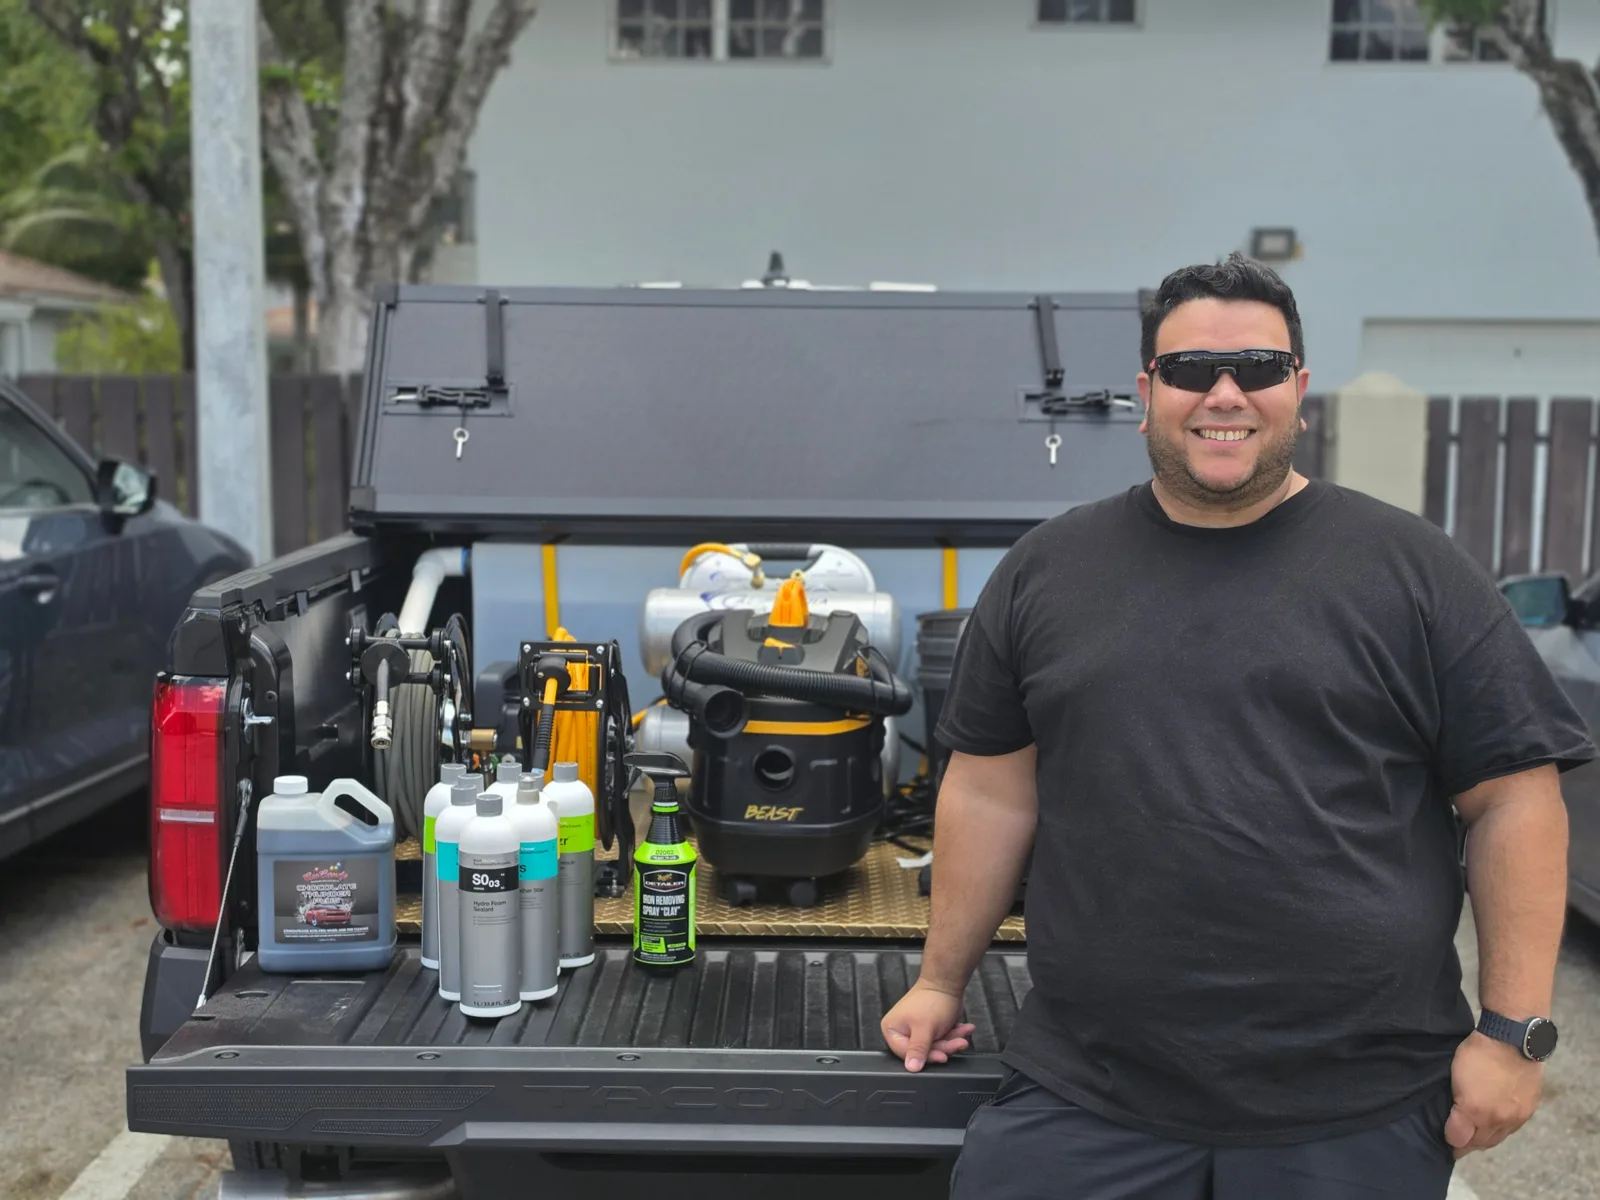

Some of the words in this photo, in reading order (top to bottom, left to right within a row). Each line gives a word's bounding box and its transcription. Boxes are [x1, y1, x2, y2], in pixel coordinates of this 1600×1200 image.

[744, 804, 804, 821] BEAST
[296, 883, 357, 892] CHOCOLATE
[301, 890, 351, 898] THUNDER
[642, 894, 655, 905] IRON
[655, 894, 685, 906] REMOVING
[642, 905, 660, 916] SPRAY
[660, 906, 681, 917] "CLAY"
[523, 1085, 929, 1113] TACOMA
